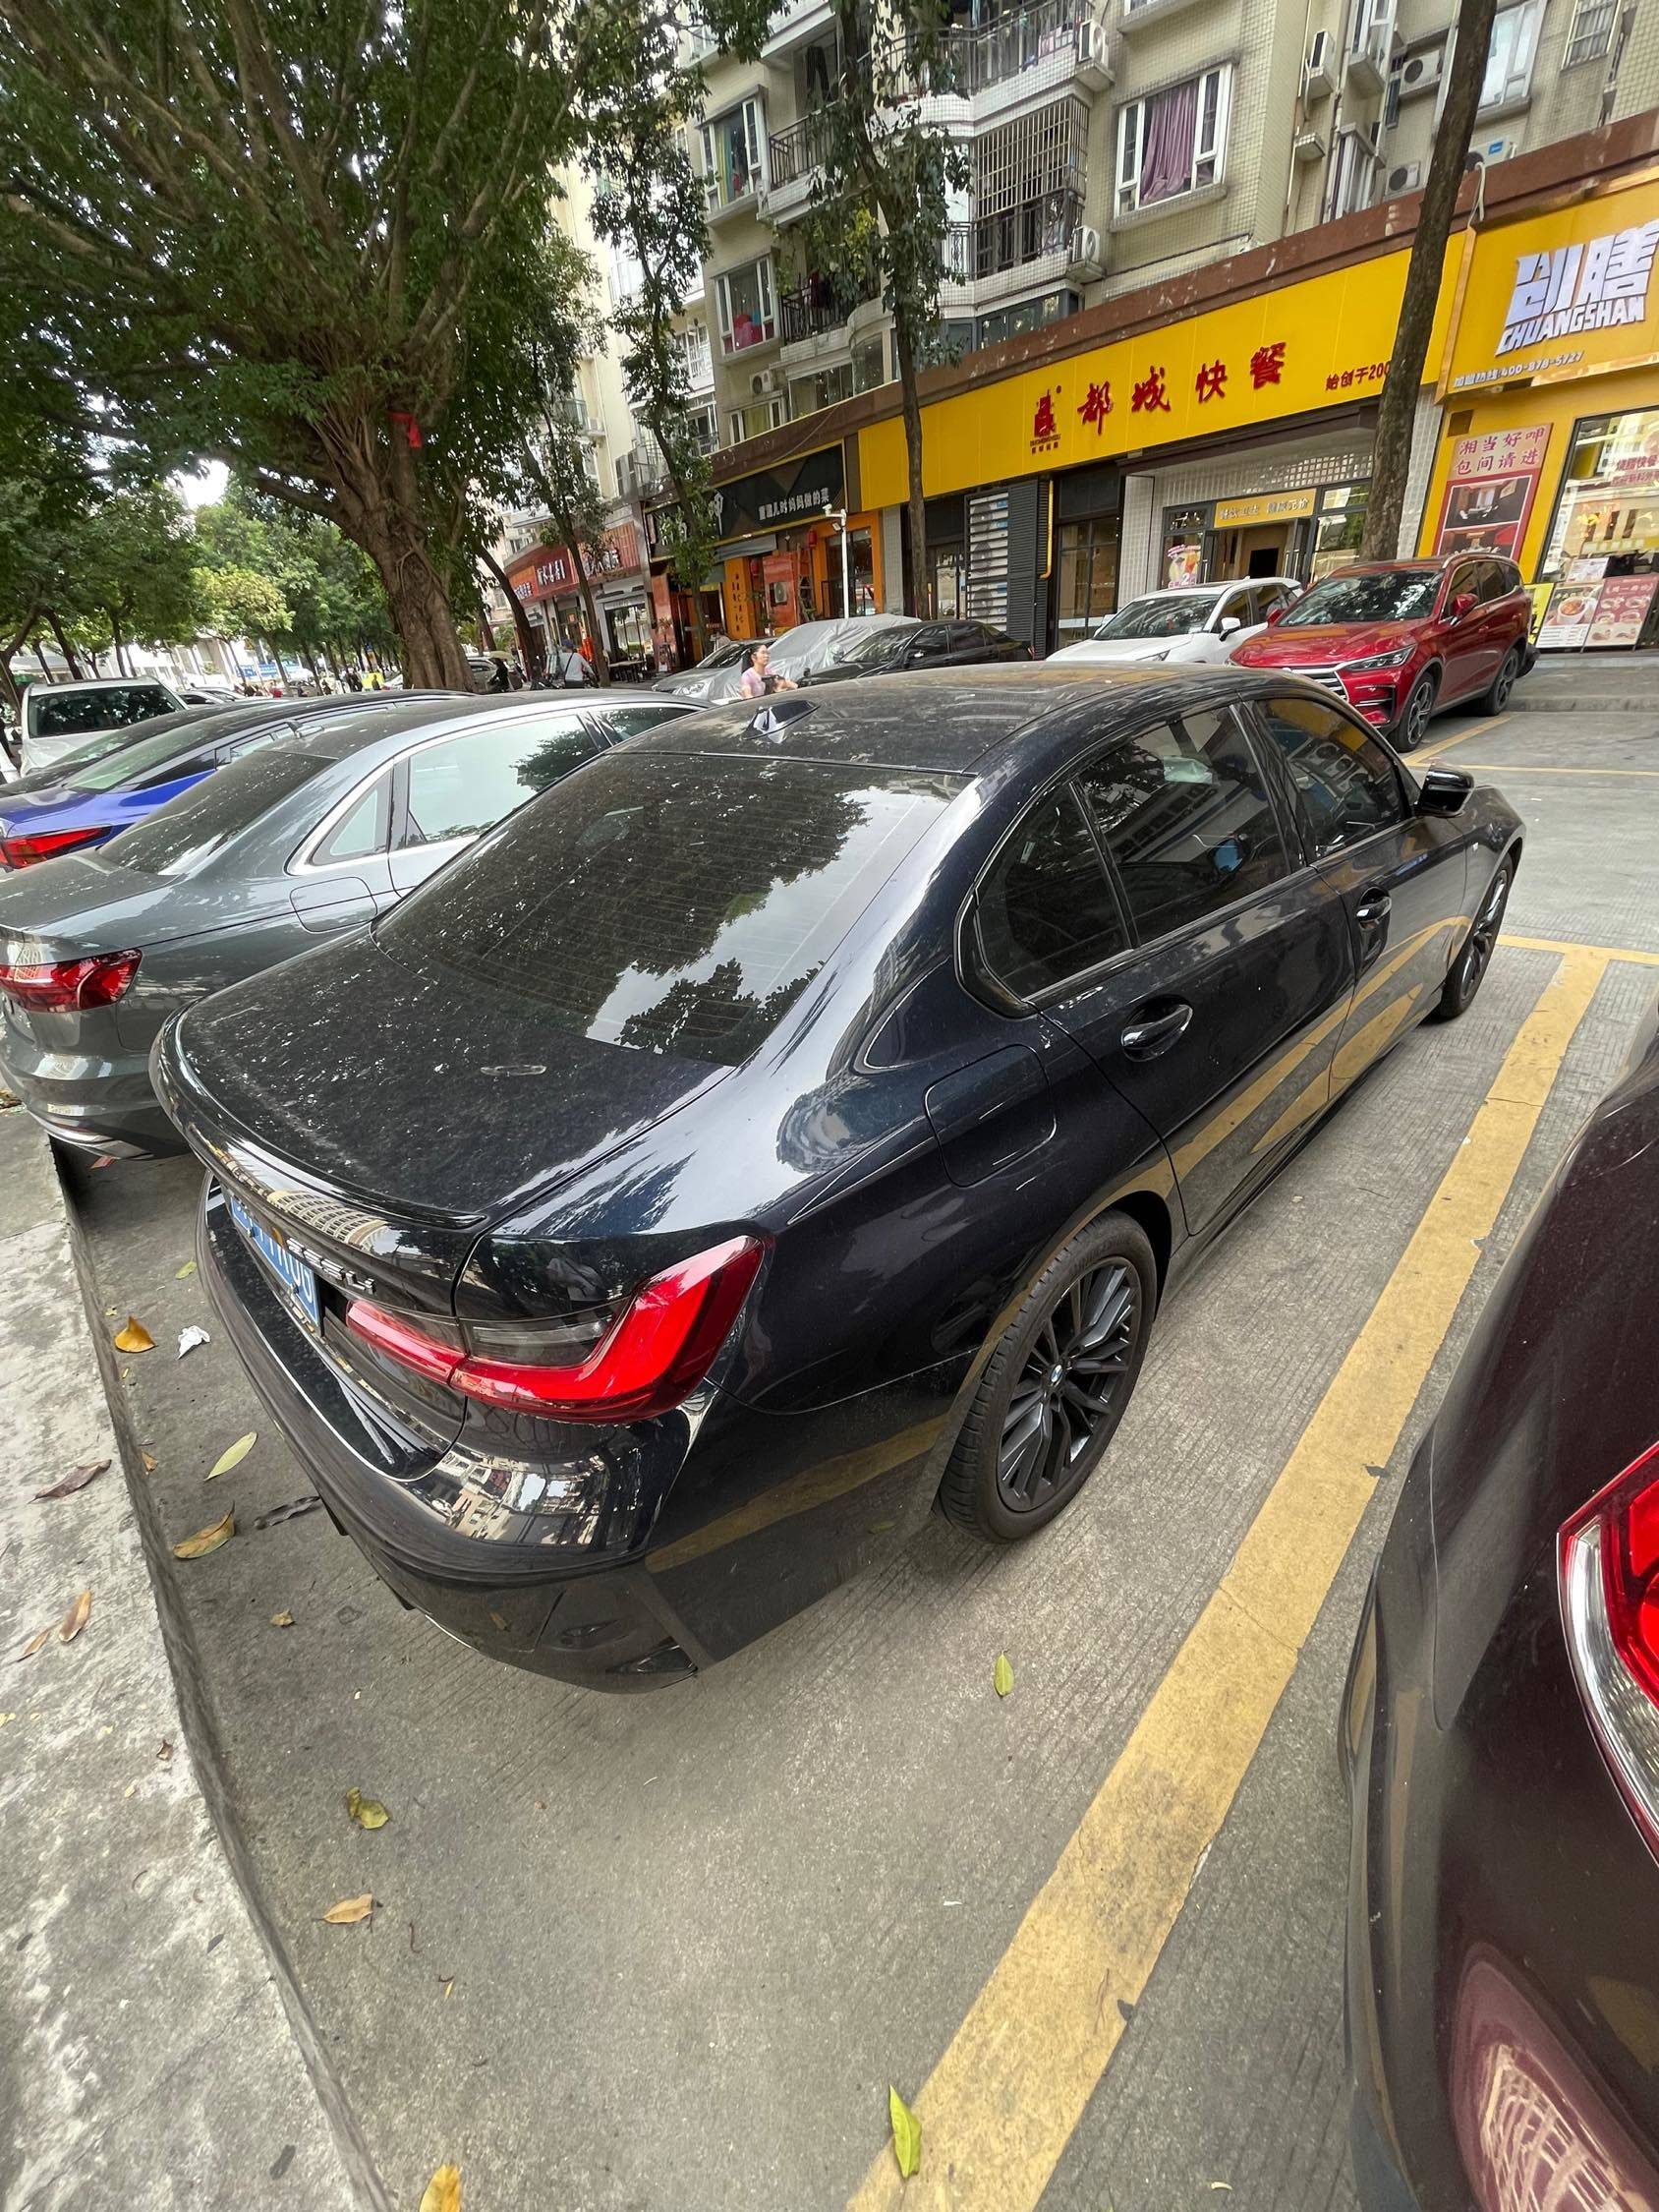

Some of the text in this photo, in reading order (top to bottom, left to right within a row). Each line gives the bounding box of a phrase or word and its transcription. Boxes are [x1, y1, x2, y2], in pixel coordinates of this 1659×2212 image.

[1495, 295, 1645, 357] CHUANGSHAN
[1077, 341, 1287, 435] 都城快餐
[1458, 448, 1539, 475] 包间请进
[1459, 427, 1545, 454] 湘当好呷
